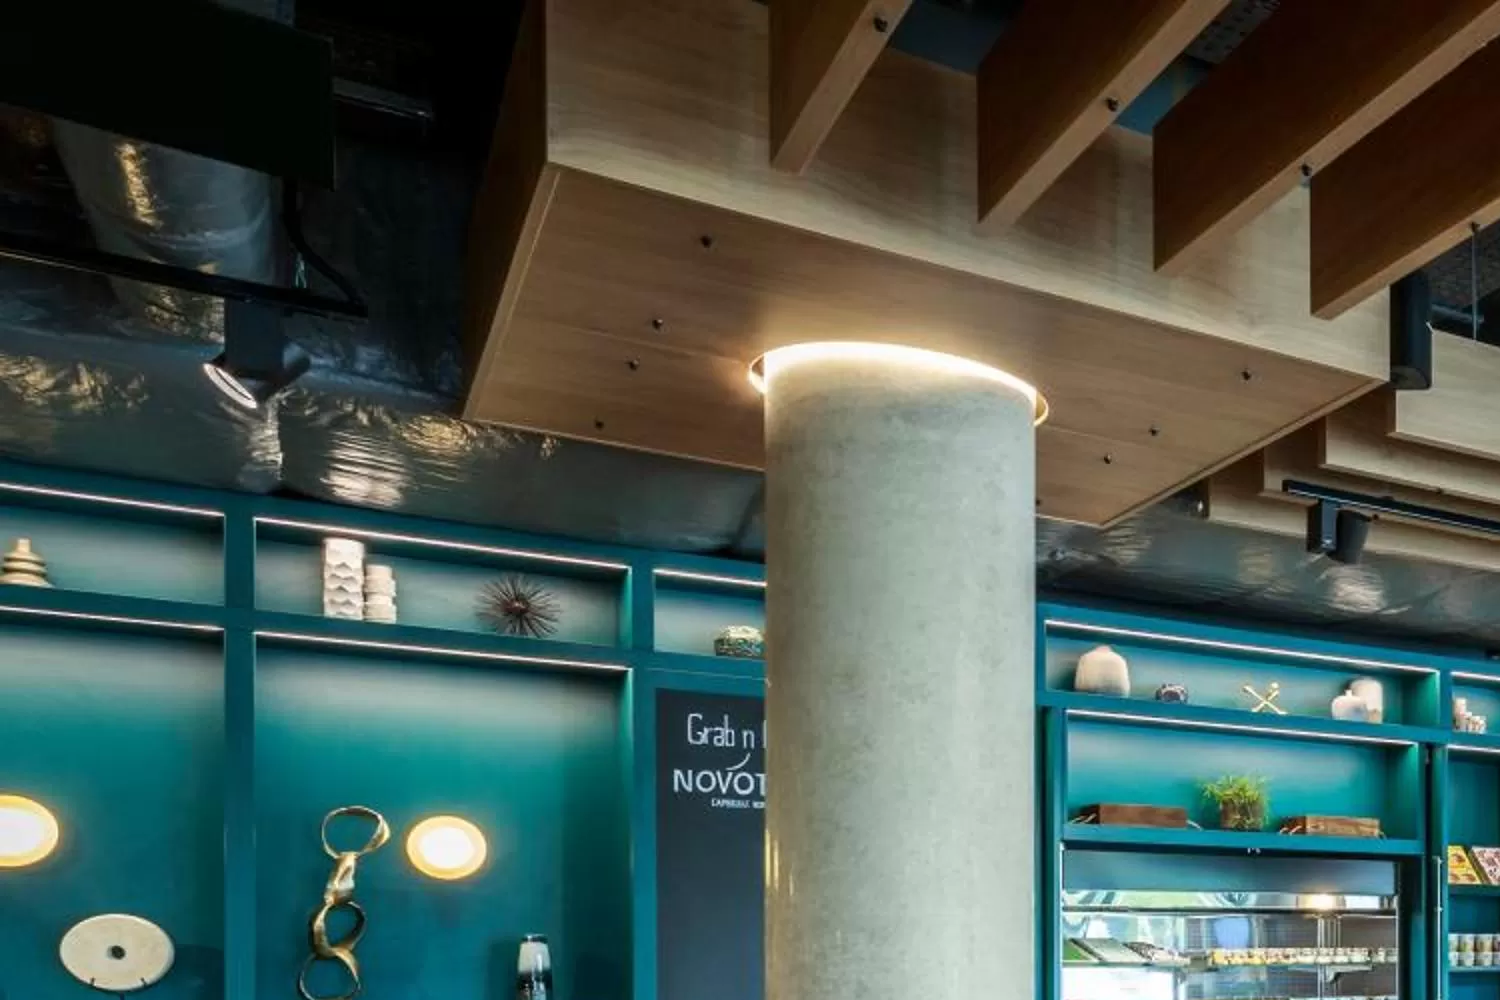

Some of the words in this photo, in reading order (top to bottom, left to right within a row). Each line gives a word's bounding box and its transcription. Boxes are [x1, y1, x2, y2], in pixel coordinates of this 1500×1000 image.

[687, 713, 736, 748] Grab
[741, 729, 755, 750] n
[673, 768, 767, 797] NOVOT
